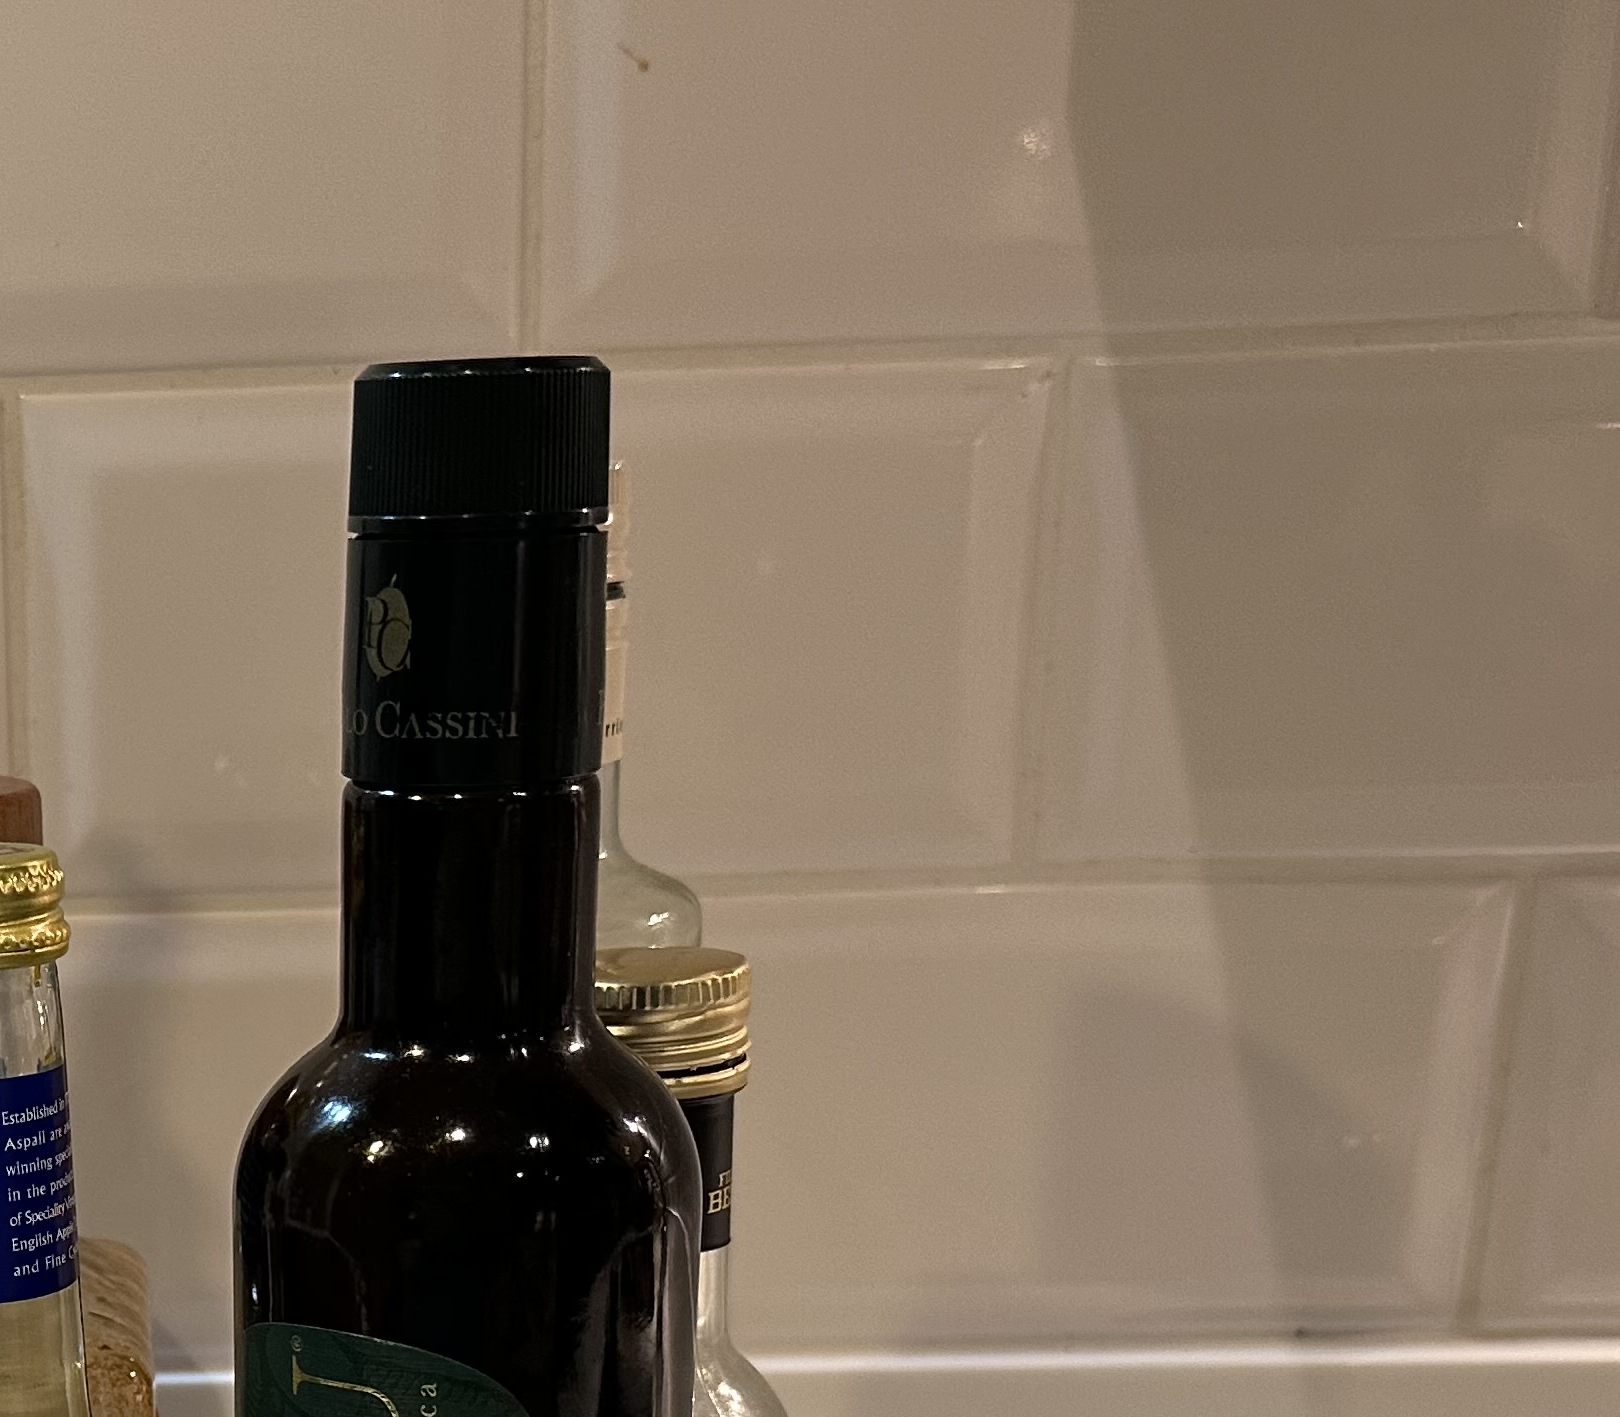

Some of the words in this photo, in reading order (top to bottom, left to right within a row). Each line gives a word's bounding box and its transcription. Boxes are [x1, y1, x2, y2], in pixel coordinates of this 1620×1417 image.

[376, 700, 520, 740] CASSINI
[1, 1101, 58, 1126] Established
[4, 1130, 46, 1152] Aspall
[50, 1126, 62, 1140] are
[6, 1155, 53, 1177] winning
[7, 1187, 21, 1202] in
[26, 1184, 46, 1199] the
[9, 1211, 23, 1227] of
[25, 1201, 66, 1226] Speciality
[11, 1230, 53, 1252] English
[13, 1258, 40, 1277] and
[45, 1251, 66, 1271] Fine
